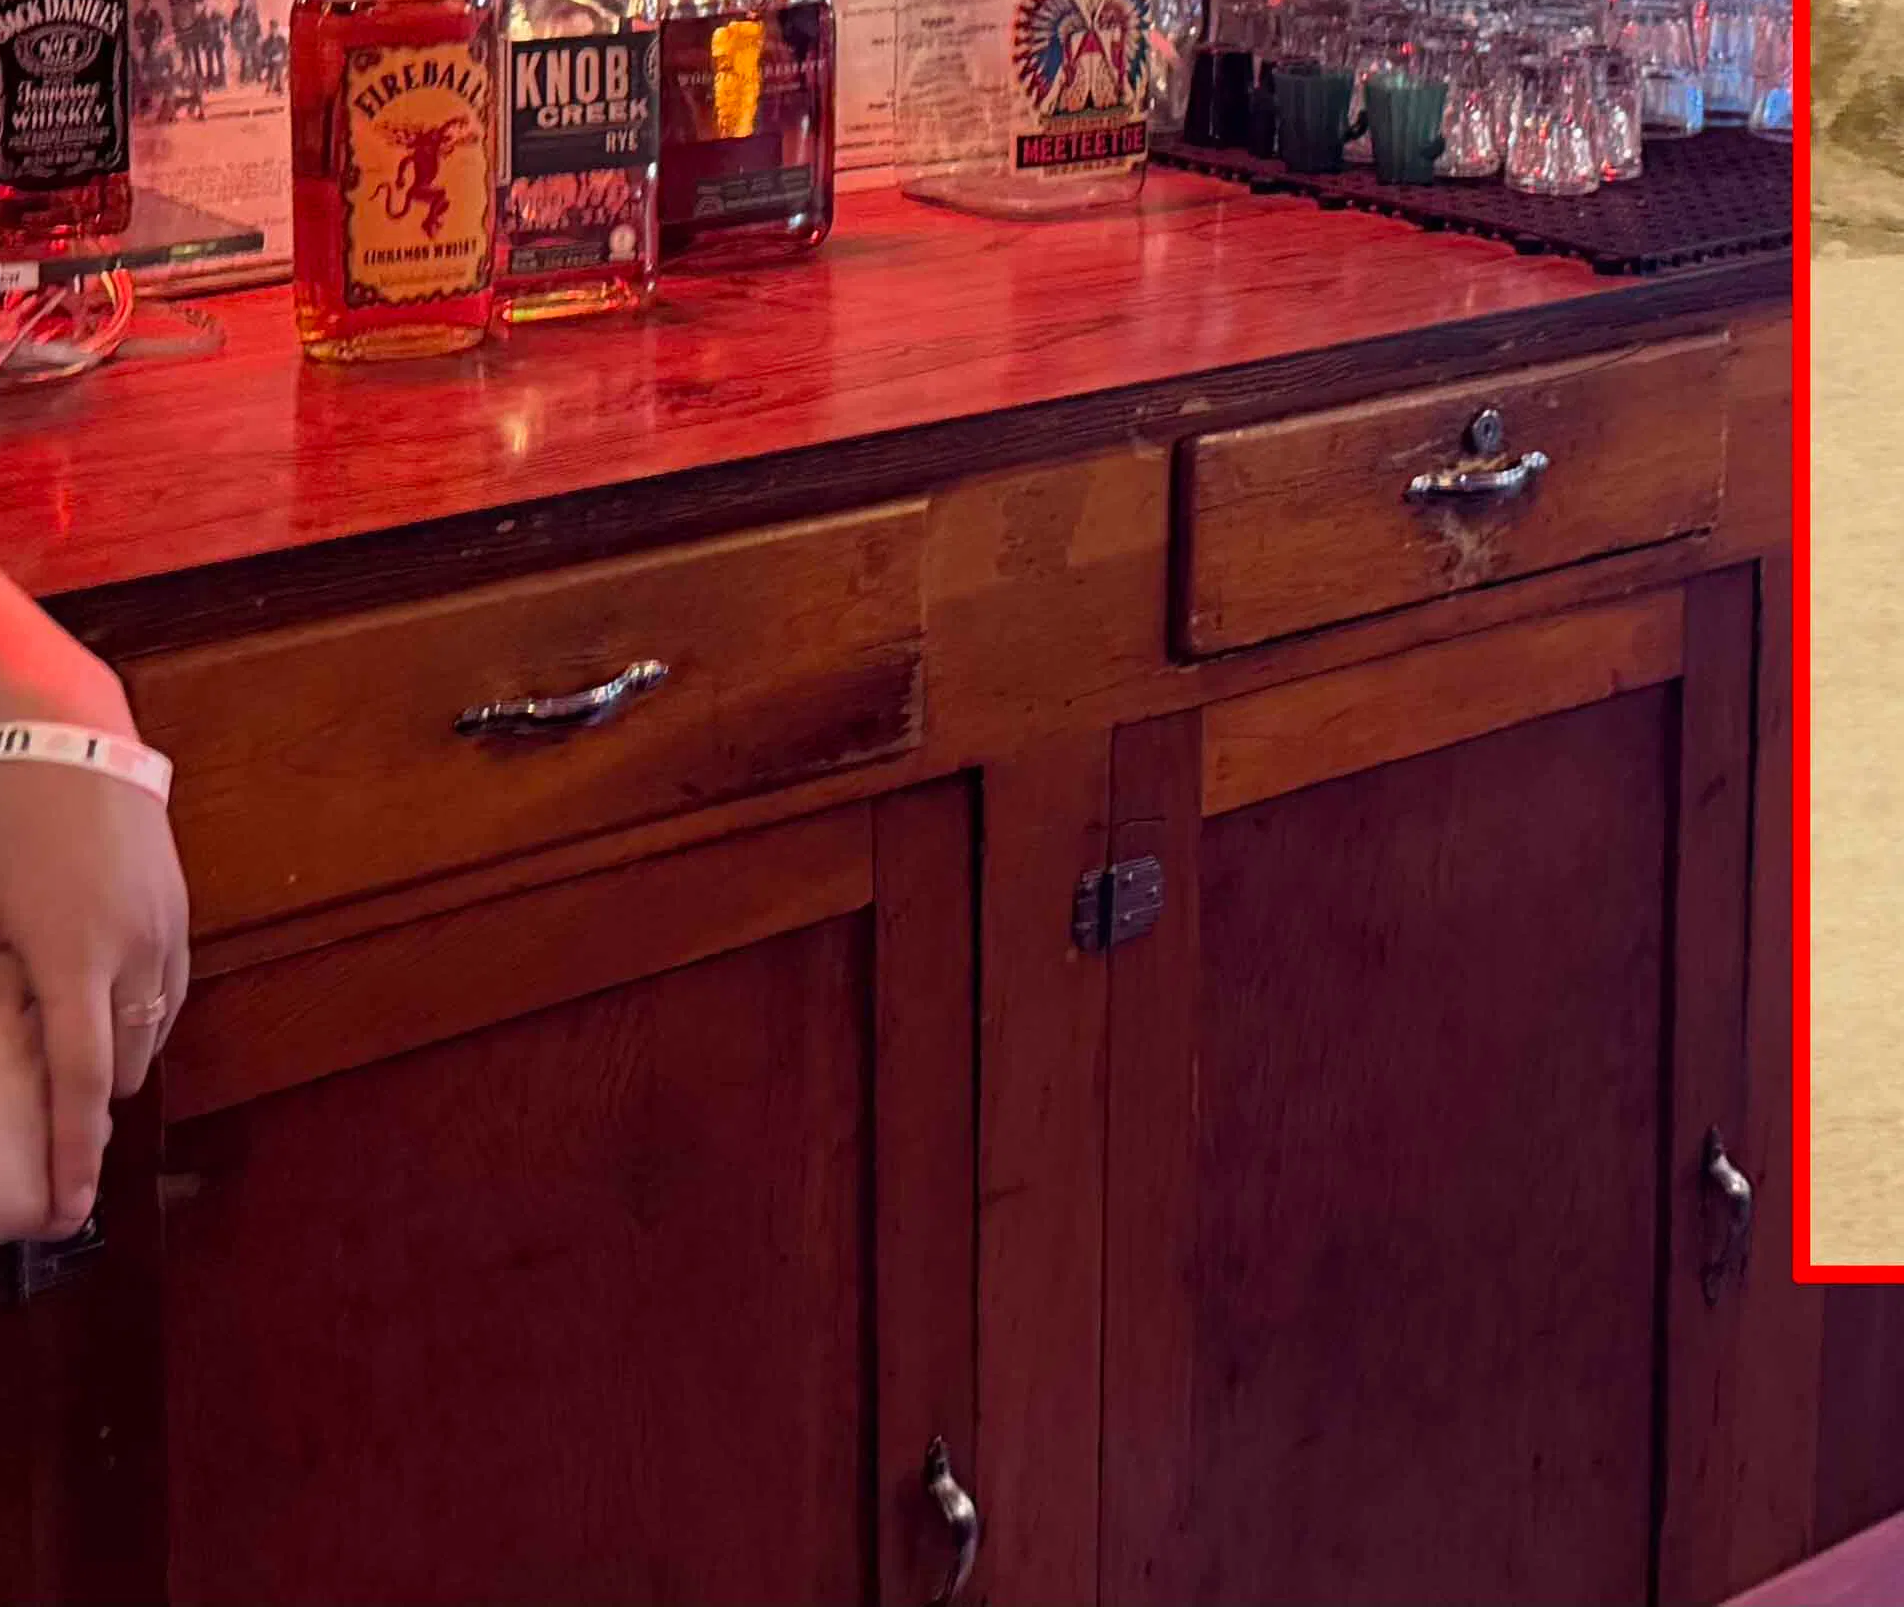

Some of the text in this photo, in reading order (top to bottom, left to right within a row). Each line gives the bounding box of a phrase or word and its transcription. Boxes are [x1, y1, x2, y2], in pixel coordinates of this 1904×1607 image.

[353, 58, 487, 121] FIREBALL
[514, 44, 630, 113] KNOB
[536, 96, 650, 129] CREEK
[604, 129, 640, 154] RYE
